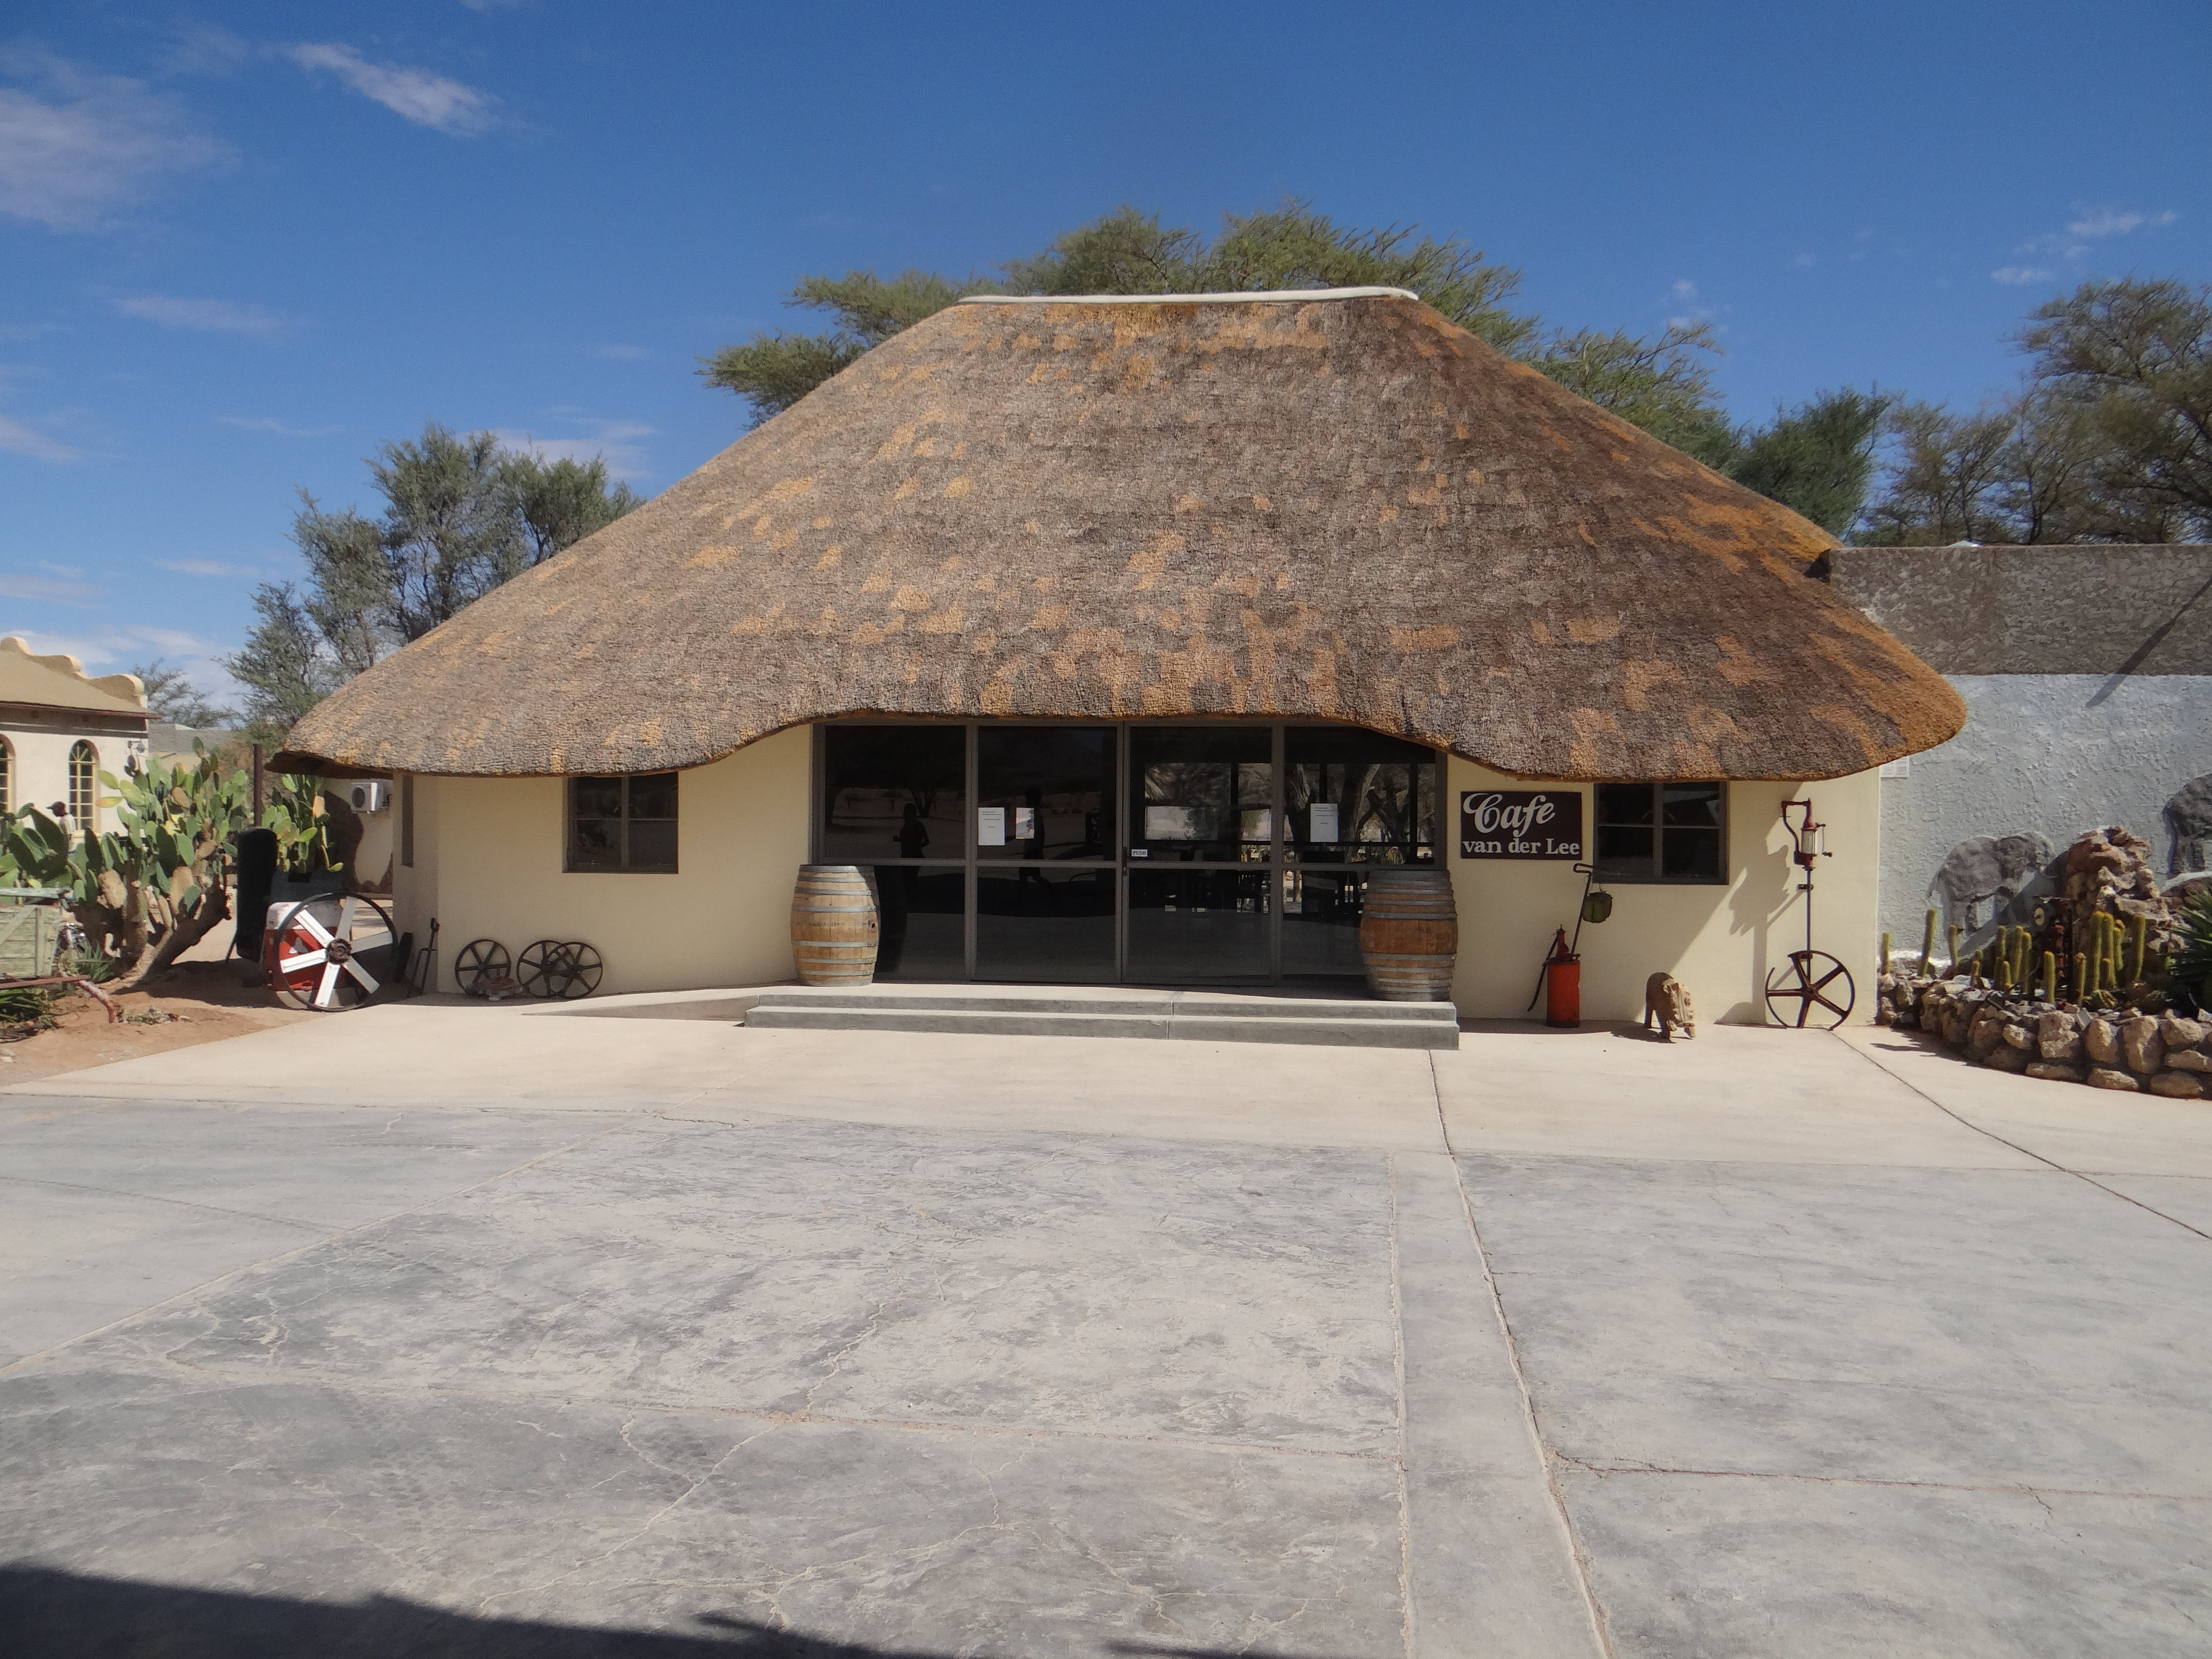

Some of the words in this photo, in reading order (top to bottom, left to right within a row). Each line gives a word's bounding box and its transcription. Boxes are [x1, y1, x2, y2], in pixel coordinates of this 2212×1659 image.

[1463, 793, 1555, 838] Cafe
[1462, 840, 1502, 853] van
[1508, 837, 1541, 854] der
[1545, 838, 1580, 855] Lee
